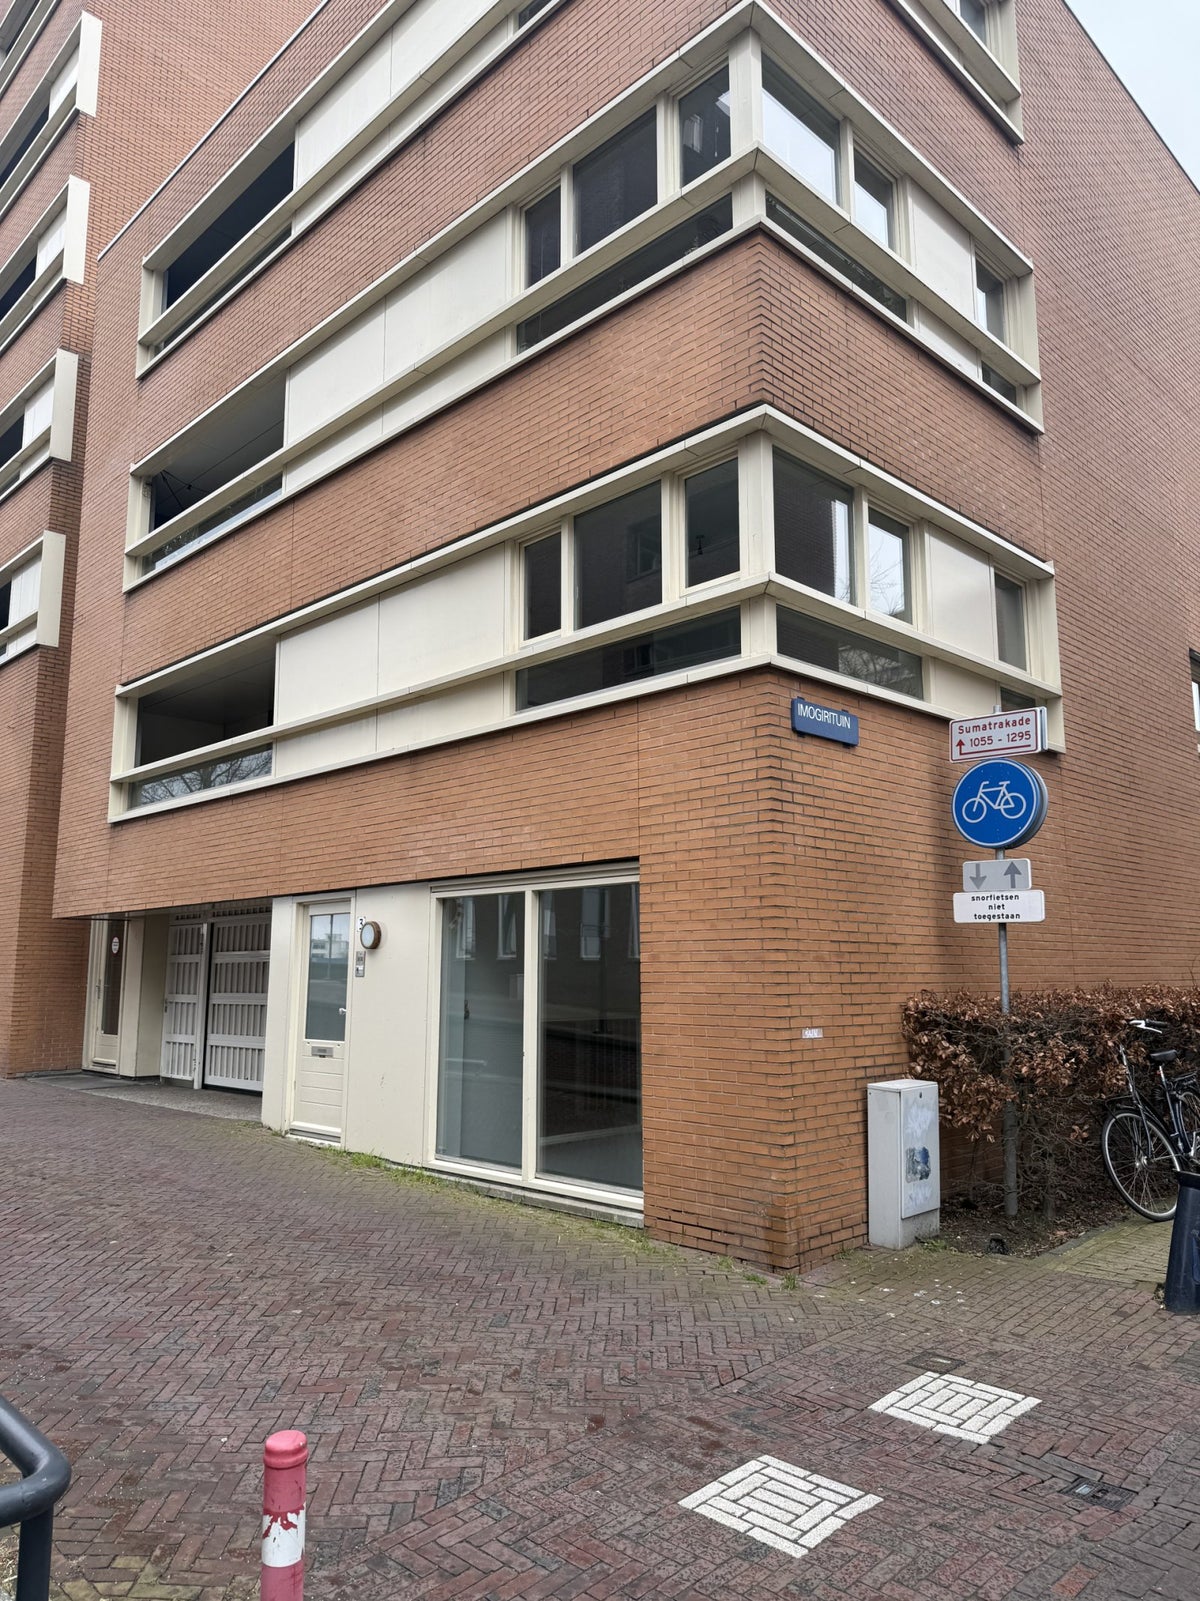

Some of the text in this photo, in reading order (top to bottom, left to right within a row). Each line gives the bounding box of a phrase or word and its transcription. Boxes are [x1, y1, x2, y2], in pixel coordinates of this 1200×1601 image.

[798, 703, 851, 729] IMOGIRITUIN
[958, 716, 1031, 734] Sumatrakade
[970, 736, 993, 747] 1055
[1007, 731, 1031, 742] 1295
[974, 913, 1021, 921] toegestaan
